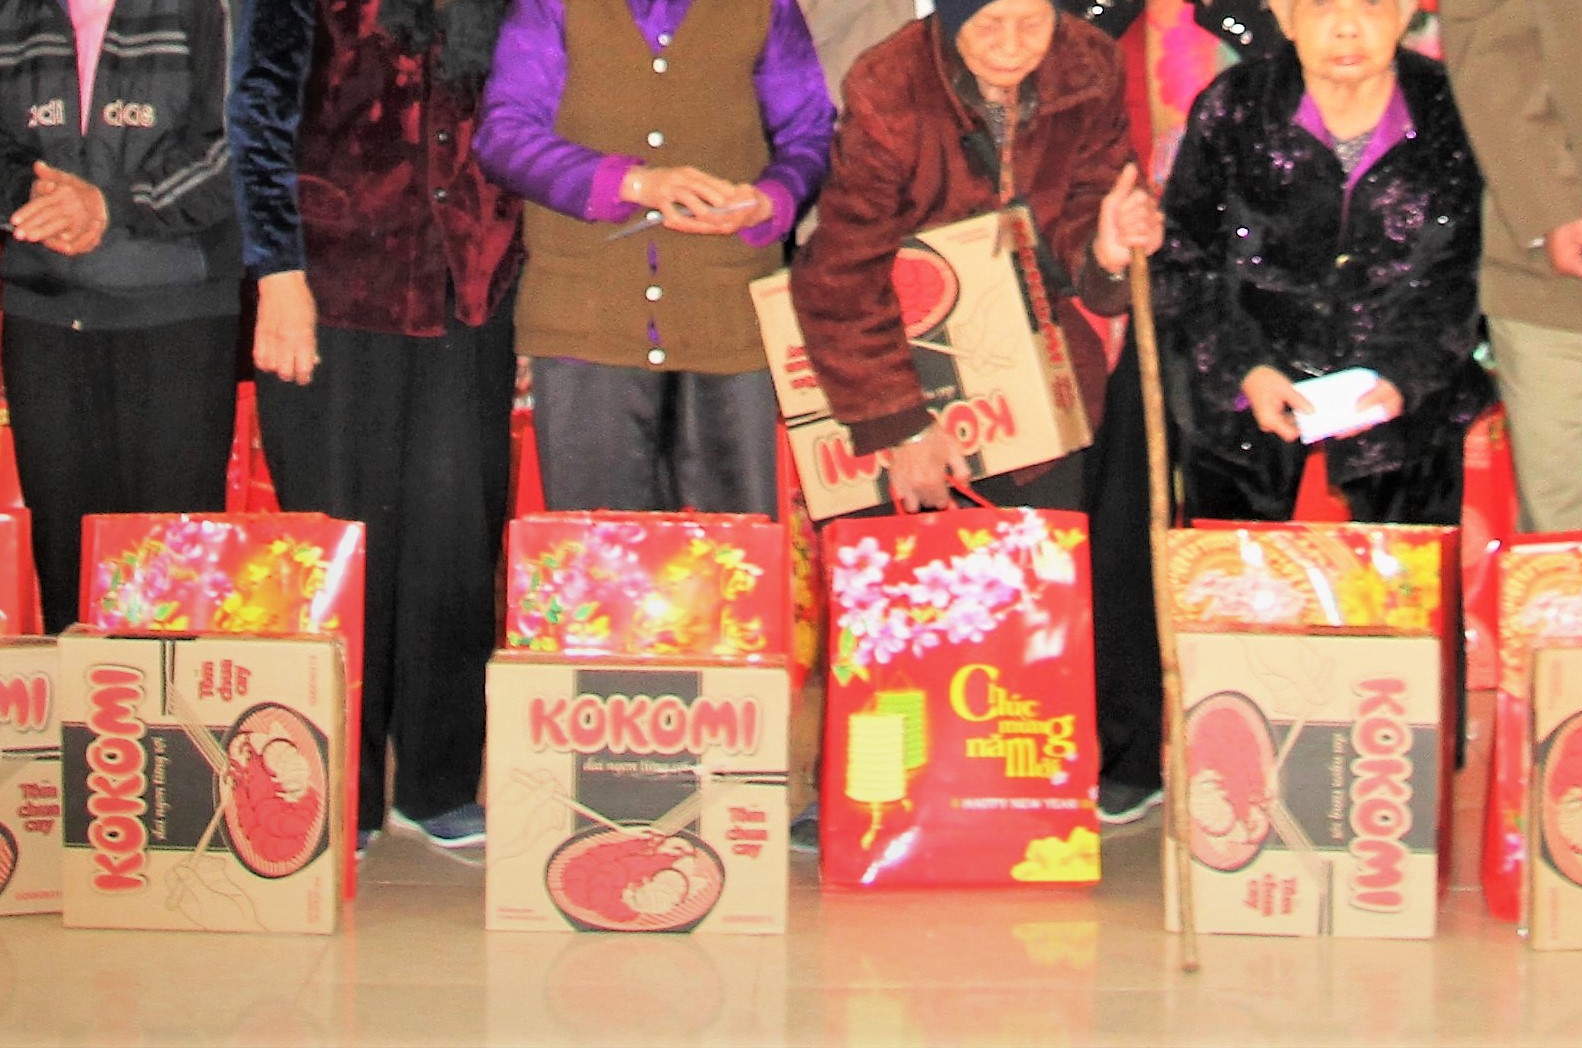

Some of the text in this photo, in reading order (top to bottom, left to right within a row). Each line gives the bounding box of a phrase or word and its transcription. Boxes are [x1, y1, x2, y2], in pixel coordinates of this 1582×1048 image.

[816, 392, 1017, 487] KOMI
[88, 665, 148, 893] KOKOMI
[529, 697, 758, 751] KOKOMI
[1353, 678, 1409, 909] KOKOMI
